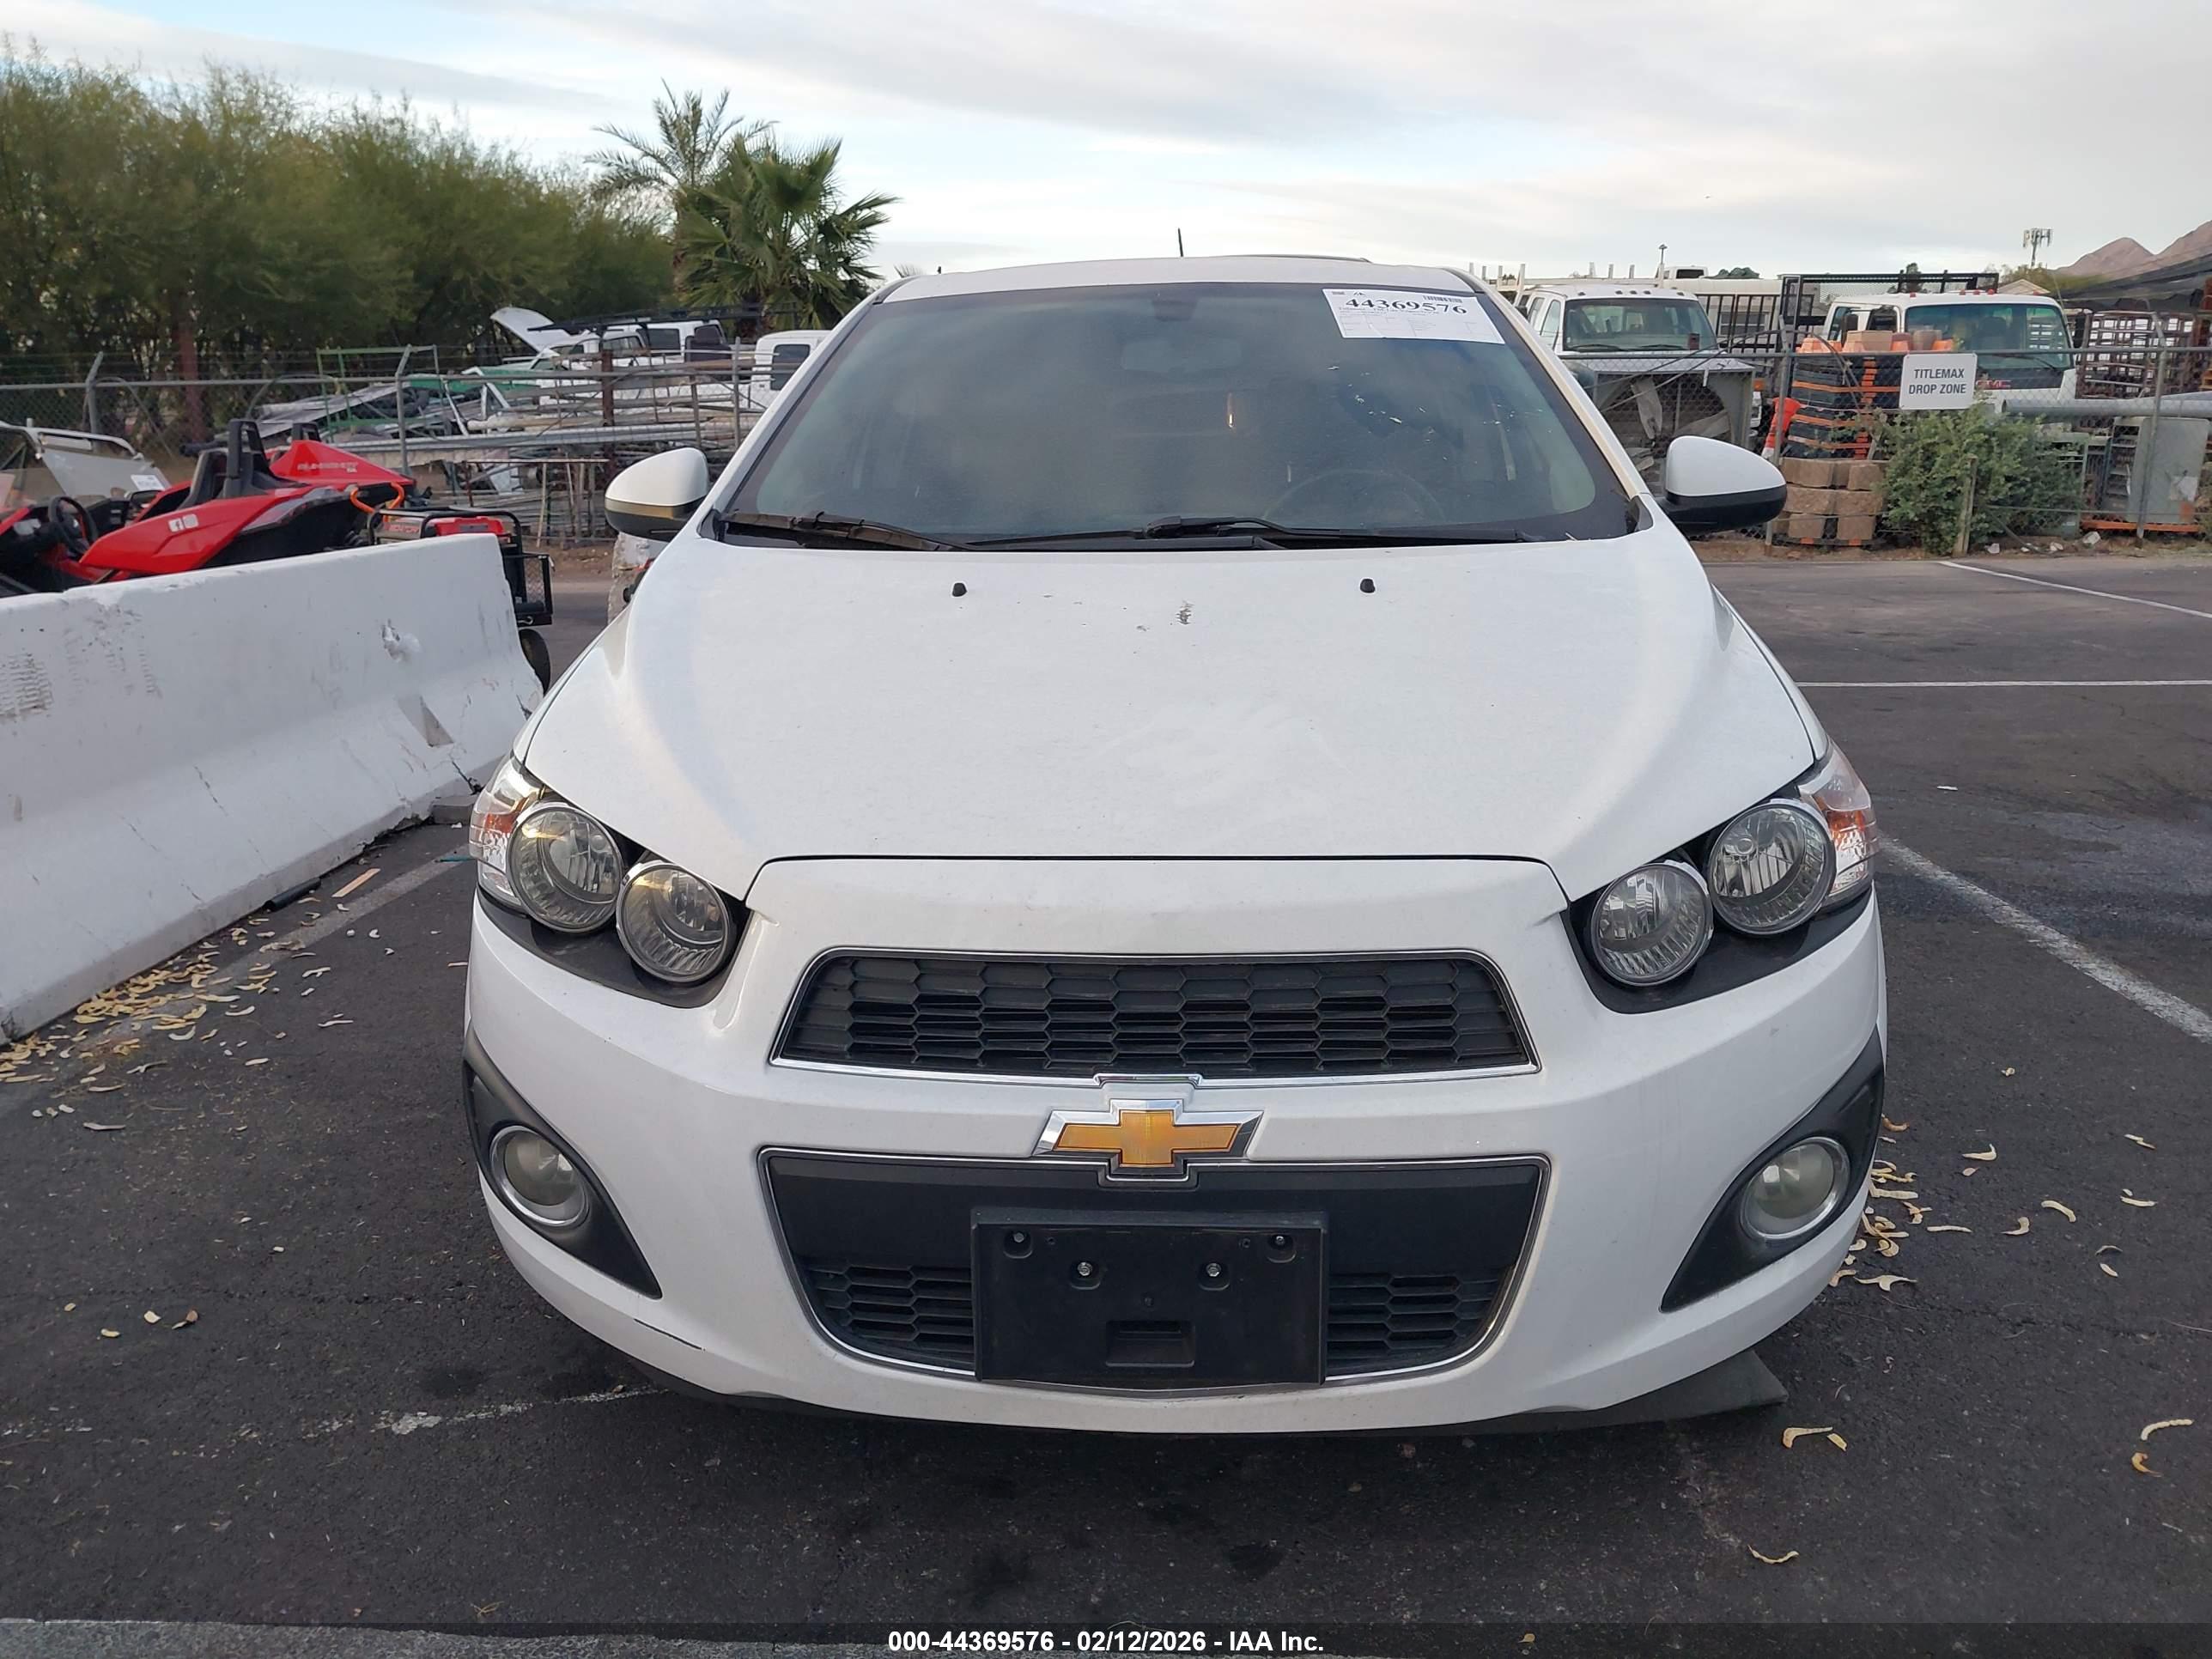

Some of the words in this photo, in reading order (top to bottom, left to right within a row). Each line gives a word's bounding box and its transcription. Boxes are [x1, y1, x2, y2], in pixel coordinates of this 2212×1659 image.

[1346, 298, 1468, 314] 44369576
[1914, 368, 1965, 379] TITLEMAX
[1909, 384, 1937, 394] DROP
[1939, 383, 1966, 394] ZONE
